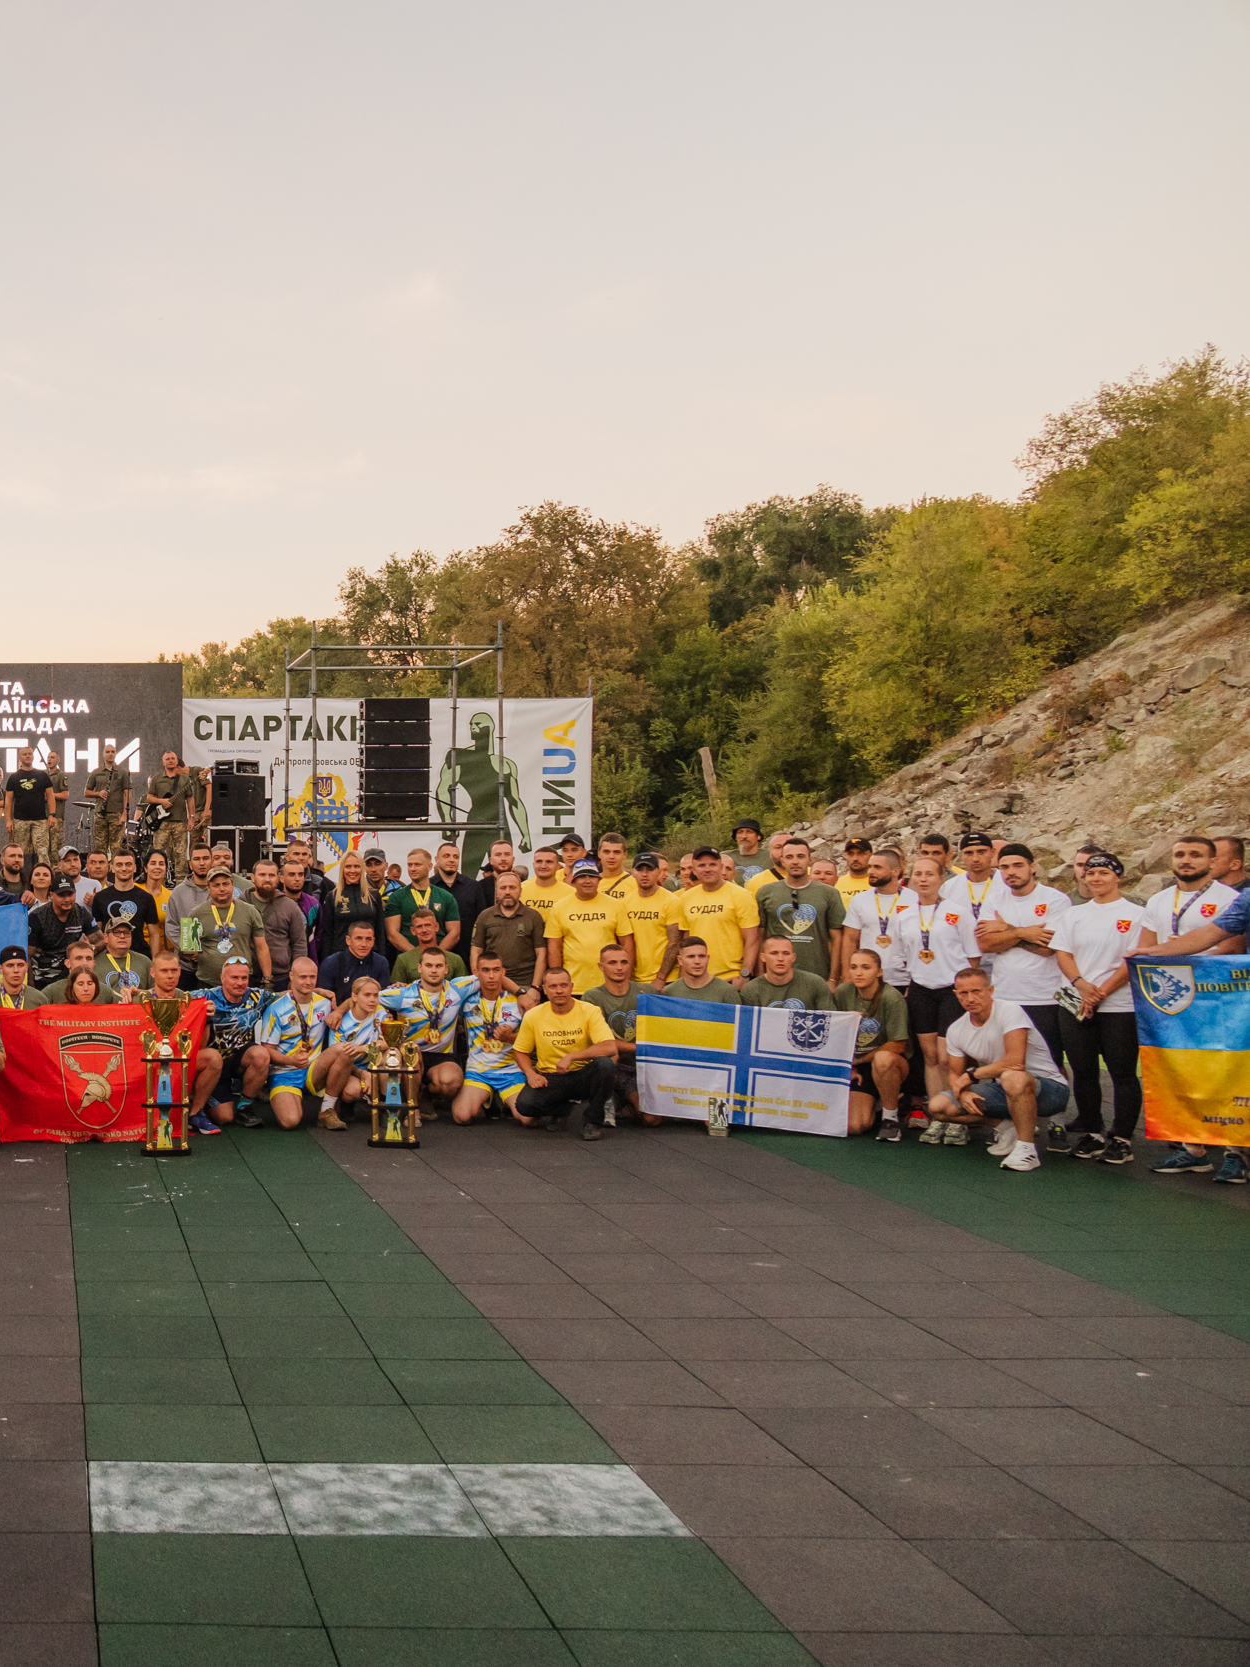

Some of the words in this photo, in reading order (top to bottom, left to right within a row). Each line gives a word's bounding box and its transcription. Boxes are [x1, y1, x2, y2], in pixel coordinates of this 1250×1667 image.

[194, 714, 358, 742] СПАРТАКІ
[525, 899, 554, 908] СУДД
[690, 904, 724, 914] СУДДЯ
[568, 912, 606, 922] СУДДЯ
[627, 910, 659, 920] СУДДЯ
[1231, 968, 1250, 980] ВІ
[542, 1028, 583, 1037] ГОЛОВНИЙ
[551, 1038, 576, 1046] СУДДЯ
[161, 1080, 167, 1091] 1
[390, 1086, 397, 1096] 3
[123, 1127, 147, 1137] NATIO
